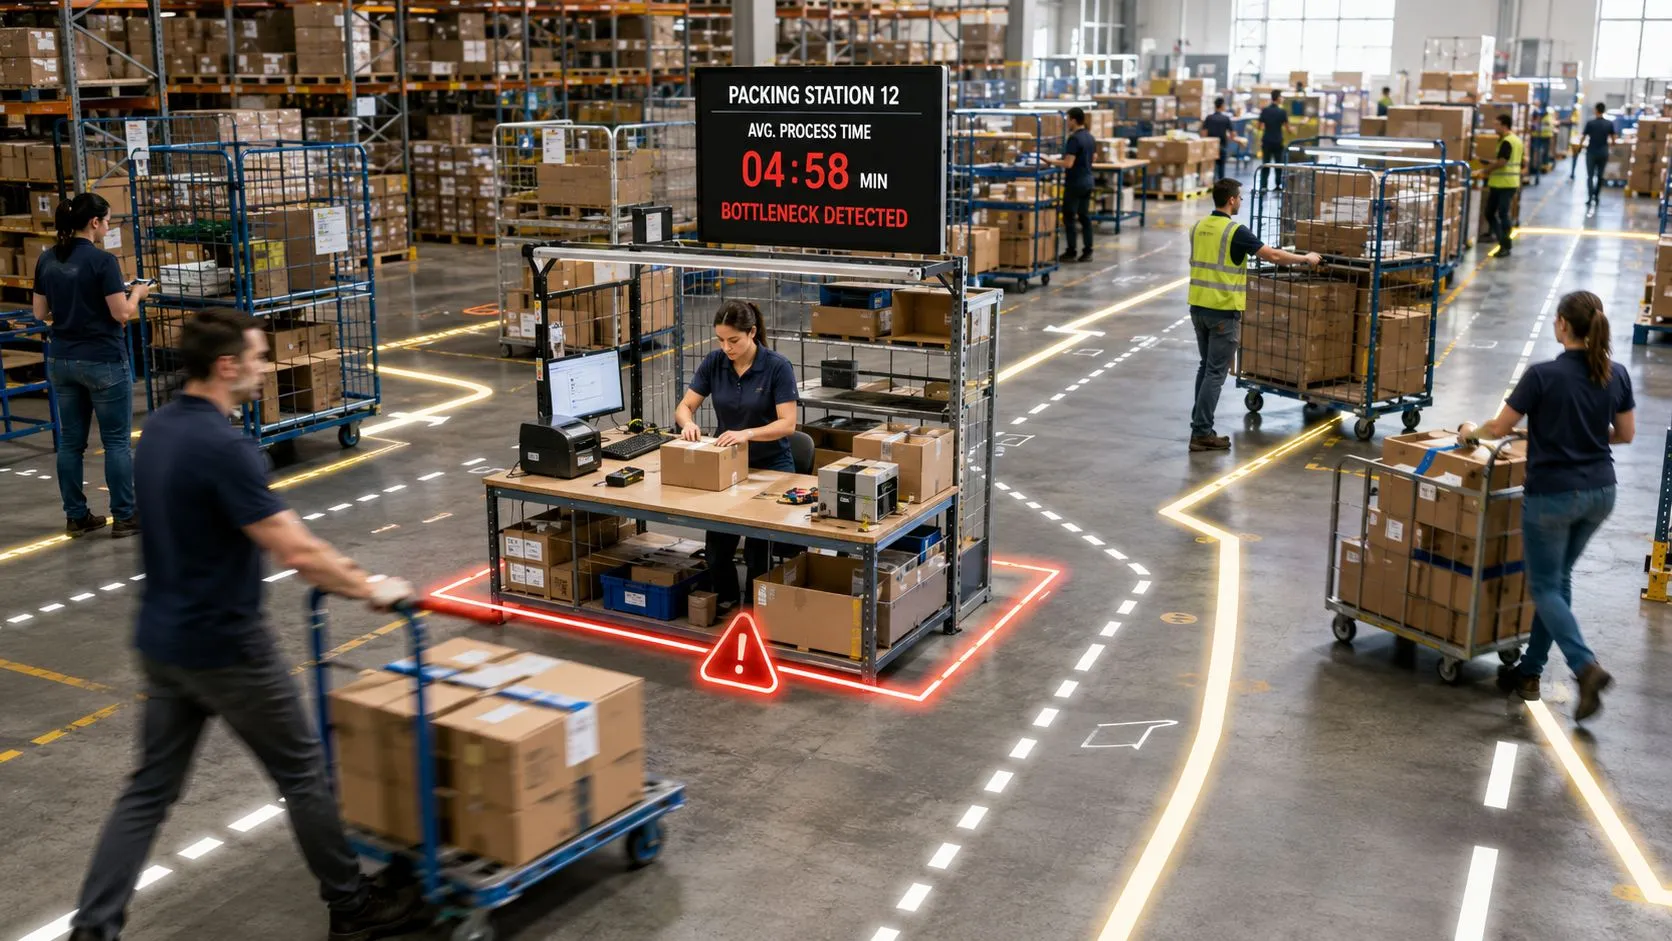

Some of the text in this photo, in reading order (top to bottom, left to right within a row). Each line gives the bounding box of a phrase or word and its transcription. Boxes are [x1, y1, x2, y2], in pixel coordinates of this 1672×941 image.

[728, 85, 900, 105] PACKING STATION 12
[748, 122, 872, 140] AVG. PROCESS TIME
[742, 150, 888, 190] 04:58 MIN
[721, 202, 908, 228] BOTTLENECK DETECTED
